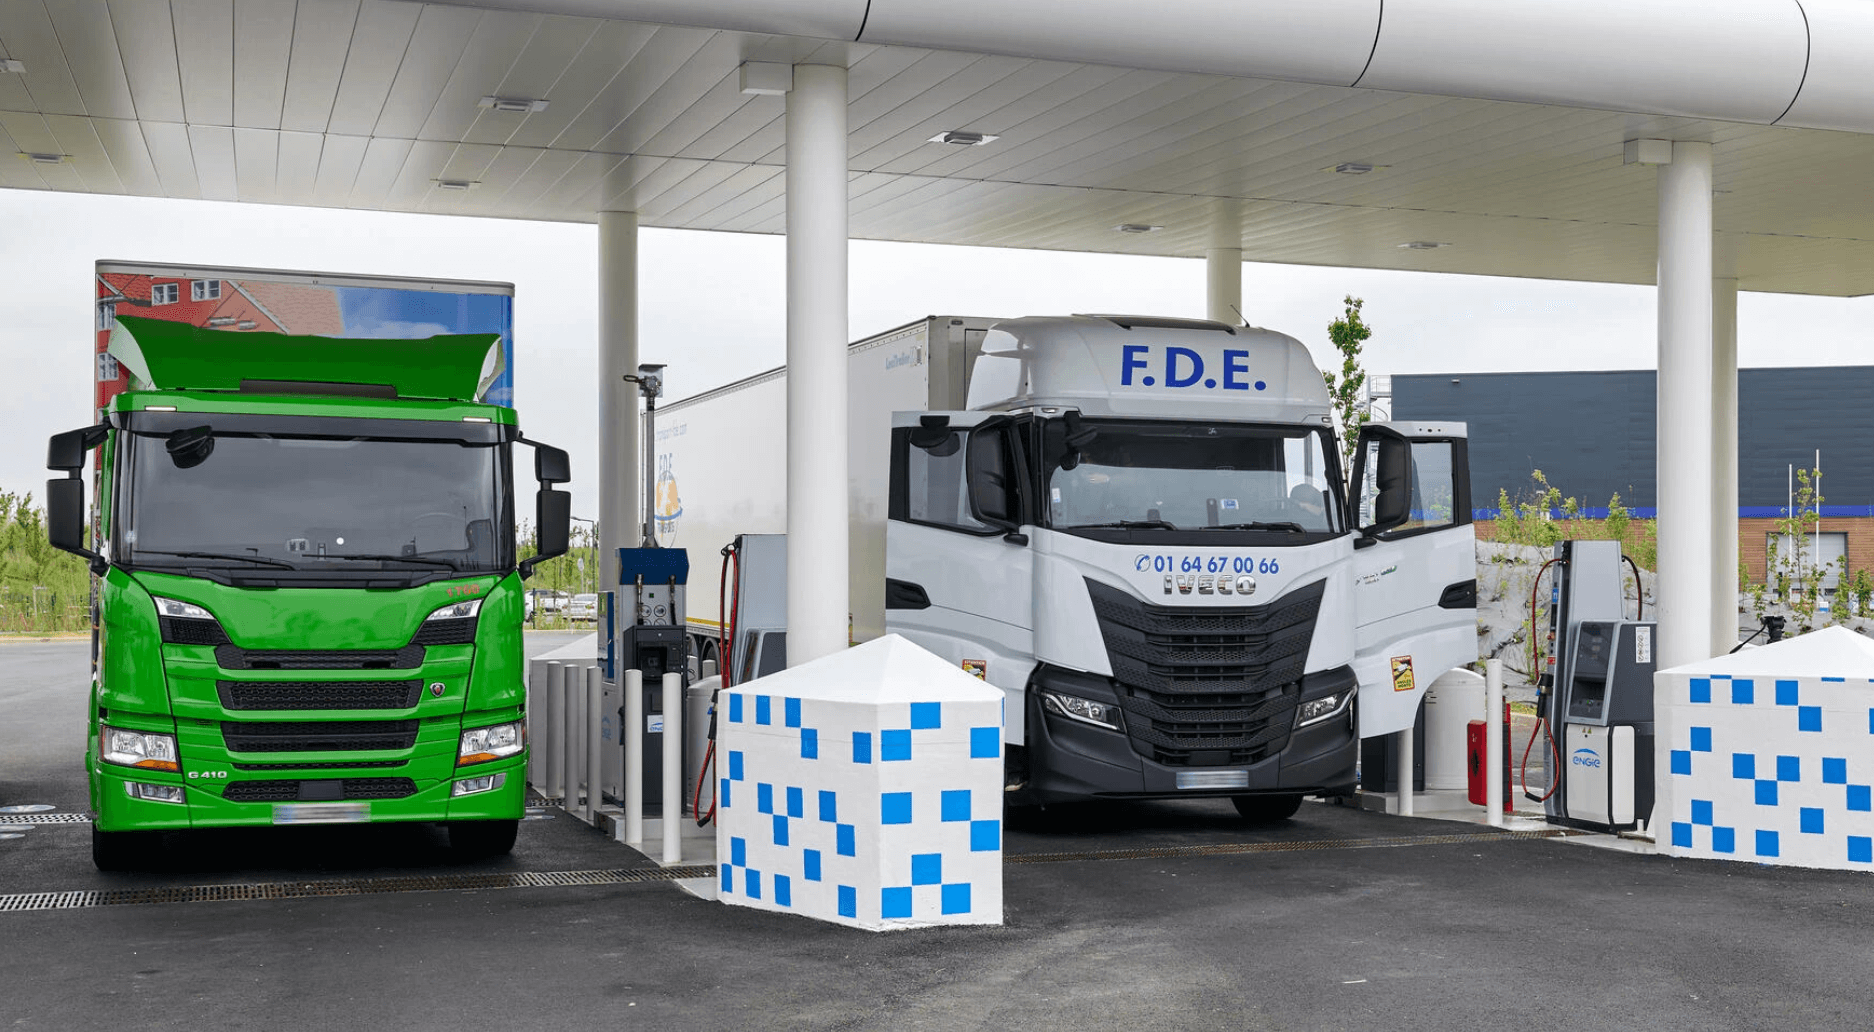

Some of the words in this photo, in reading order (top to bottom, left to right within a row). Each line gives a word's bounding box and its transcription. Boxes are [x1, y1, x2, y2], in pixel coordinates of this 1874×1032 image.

[1121, 344, 1267, 391] F.D.E.
[1154, 555, 1173, 573] 01
[1181, 556, 1202, 573] 64
[1207, 556, 1228, 573] 67
[1233, 556, 1254, 573] 00
[1259, 558, 1279, 574] 66
[1164, 575, 1257, 595] IVECO
